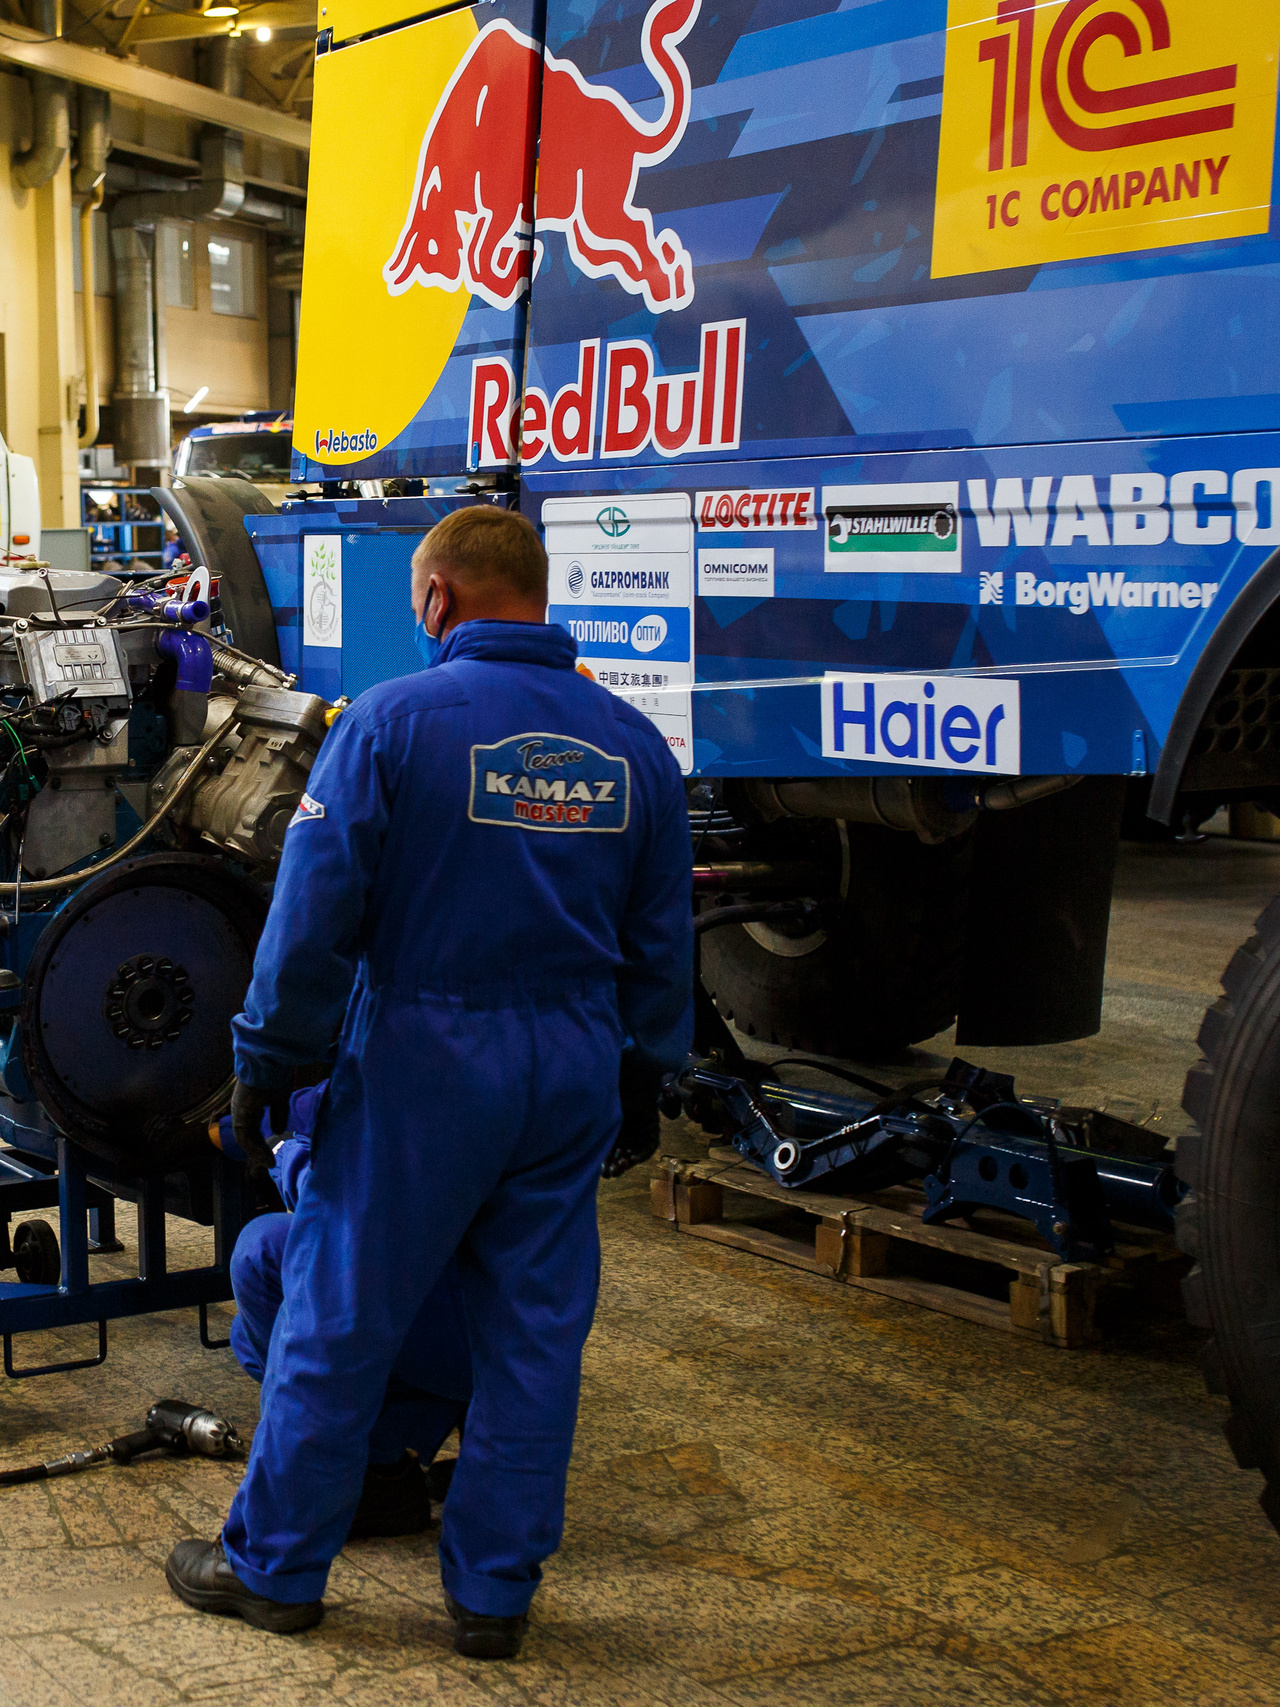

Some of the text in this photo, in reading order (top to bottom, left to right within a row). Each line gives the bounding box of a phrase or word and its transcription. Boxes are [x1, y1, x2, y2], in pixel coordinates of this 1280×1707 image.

[986, 155, 1231, 229] 1C COMPANY
[469, 318, 746, 466] Red Bull
[315, 428, 377, 456] Webasto
[701, 492, 811, 528] LOCTITE
[967, 468, 1280, 546] WABCO
[851, 515, 928, 534] STAHLWILLE
[591, 571, 670, 589] GAZPROMBANK
[704, 564, 768, 574] OMNICOMM
[1015, 572, 1218, 614] BorgWarner
[568, 620, 661, 644] ТОПЛИВО ОПТИ
[833, 681, 1005, 766] Haier
[517, 740, 584, 772] Team
[484, 769, 617, 803] KAMAZ
[514, 799, 594, 823] master
